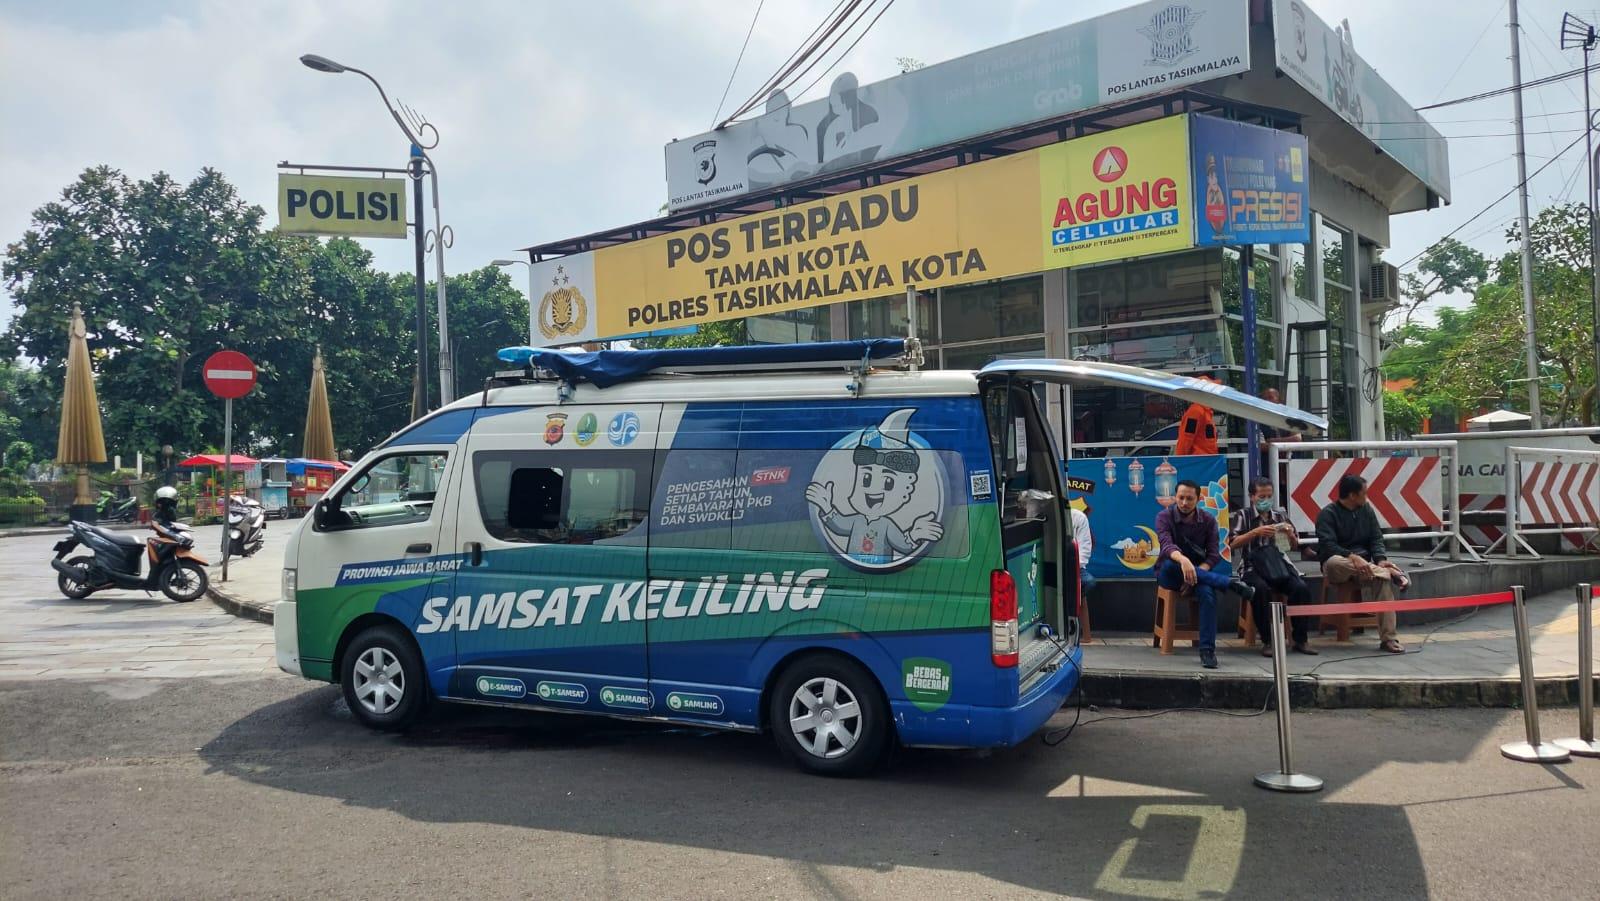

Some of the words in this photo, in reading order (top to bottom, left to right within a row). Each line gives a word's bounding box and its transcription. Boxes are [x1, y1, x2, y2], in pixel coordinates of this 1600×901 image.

[1107, 84, 1127, 96] POS
[1128, 74, 1167, 91] LANTAS
[1168, 56, 1240, 81] TASIKMALAYA
[1033, 80, 1083, 111] Grab
[286, 188, 399, 221] POLISI
[1053, 177, 1178, 228] AGUNG
[1231, 189, 1302, 223] PRESISI
[666, 227, 731, 269] POS
[739, 184, 920, 254] TERPADU
[1055, 212, 1174, 244] CELLULAR
[1100, 236, 1134, 247] TERJAMIN
[1141, 229, 1178, 240] TERPERCAYA
[704, 254, 790, 290] TAMAN
[797, 239, 870, 275] KOTA
[628, 295, 709, 328] POLRES
[717, 263, 895, 314] TASIKMALAYA
[902, 247, 988, 284] KOTA
[667, 475, 748, 495] PENGESAHAN
[755, 469, 787, 482] STNK
[1067, 479, 1091, 491] ARAT
[662, 498, 744, 516] PEMBAYARAN
[747, 495, 773, 508] PKB
[665, 492, 706, 506] SETIAP
[708, 486, 753, 502] TAHUN,
[660, 515, 686, 526] DAN
[688, 509, 744, 524] SWDKLLJ
[342, 565, 393, 580] PROVINSI
[393, 562, 424, 576] JAWA
[425, 560, 464, 573] BARAT
[416, 582, 605, 635] SAMSAT
[601, 568, 830, 625] KELILING
[913, 665, 942, 680] BEBAS
[489, 683, 523, 693] E-SAMSAT
[550, 688, 585, 698] T-SAMSAT
[684, 699, 718, 710] SAMLING
